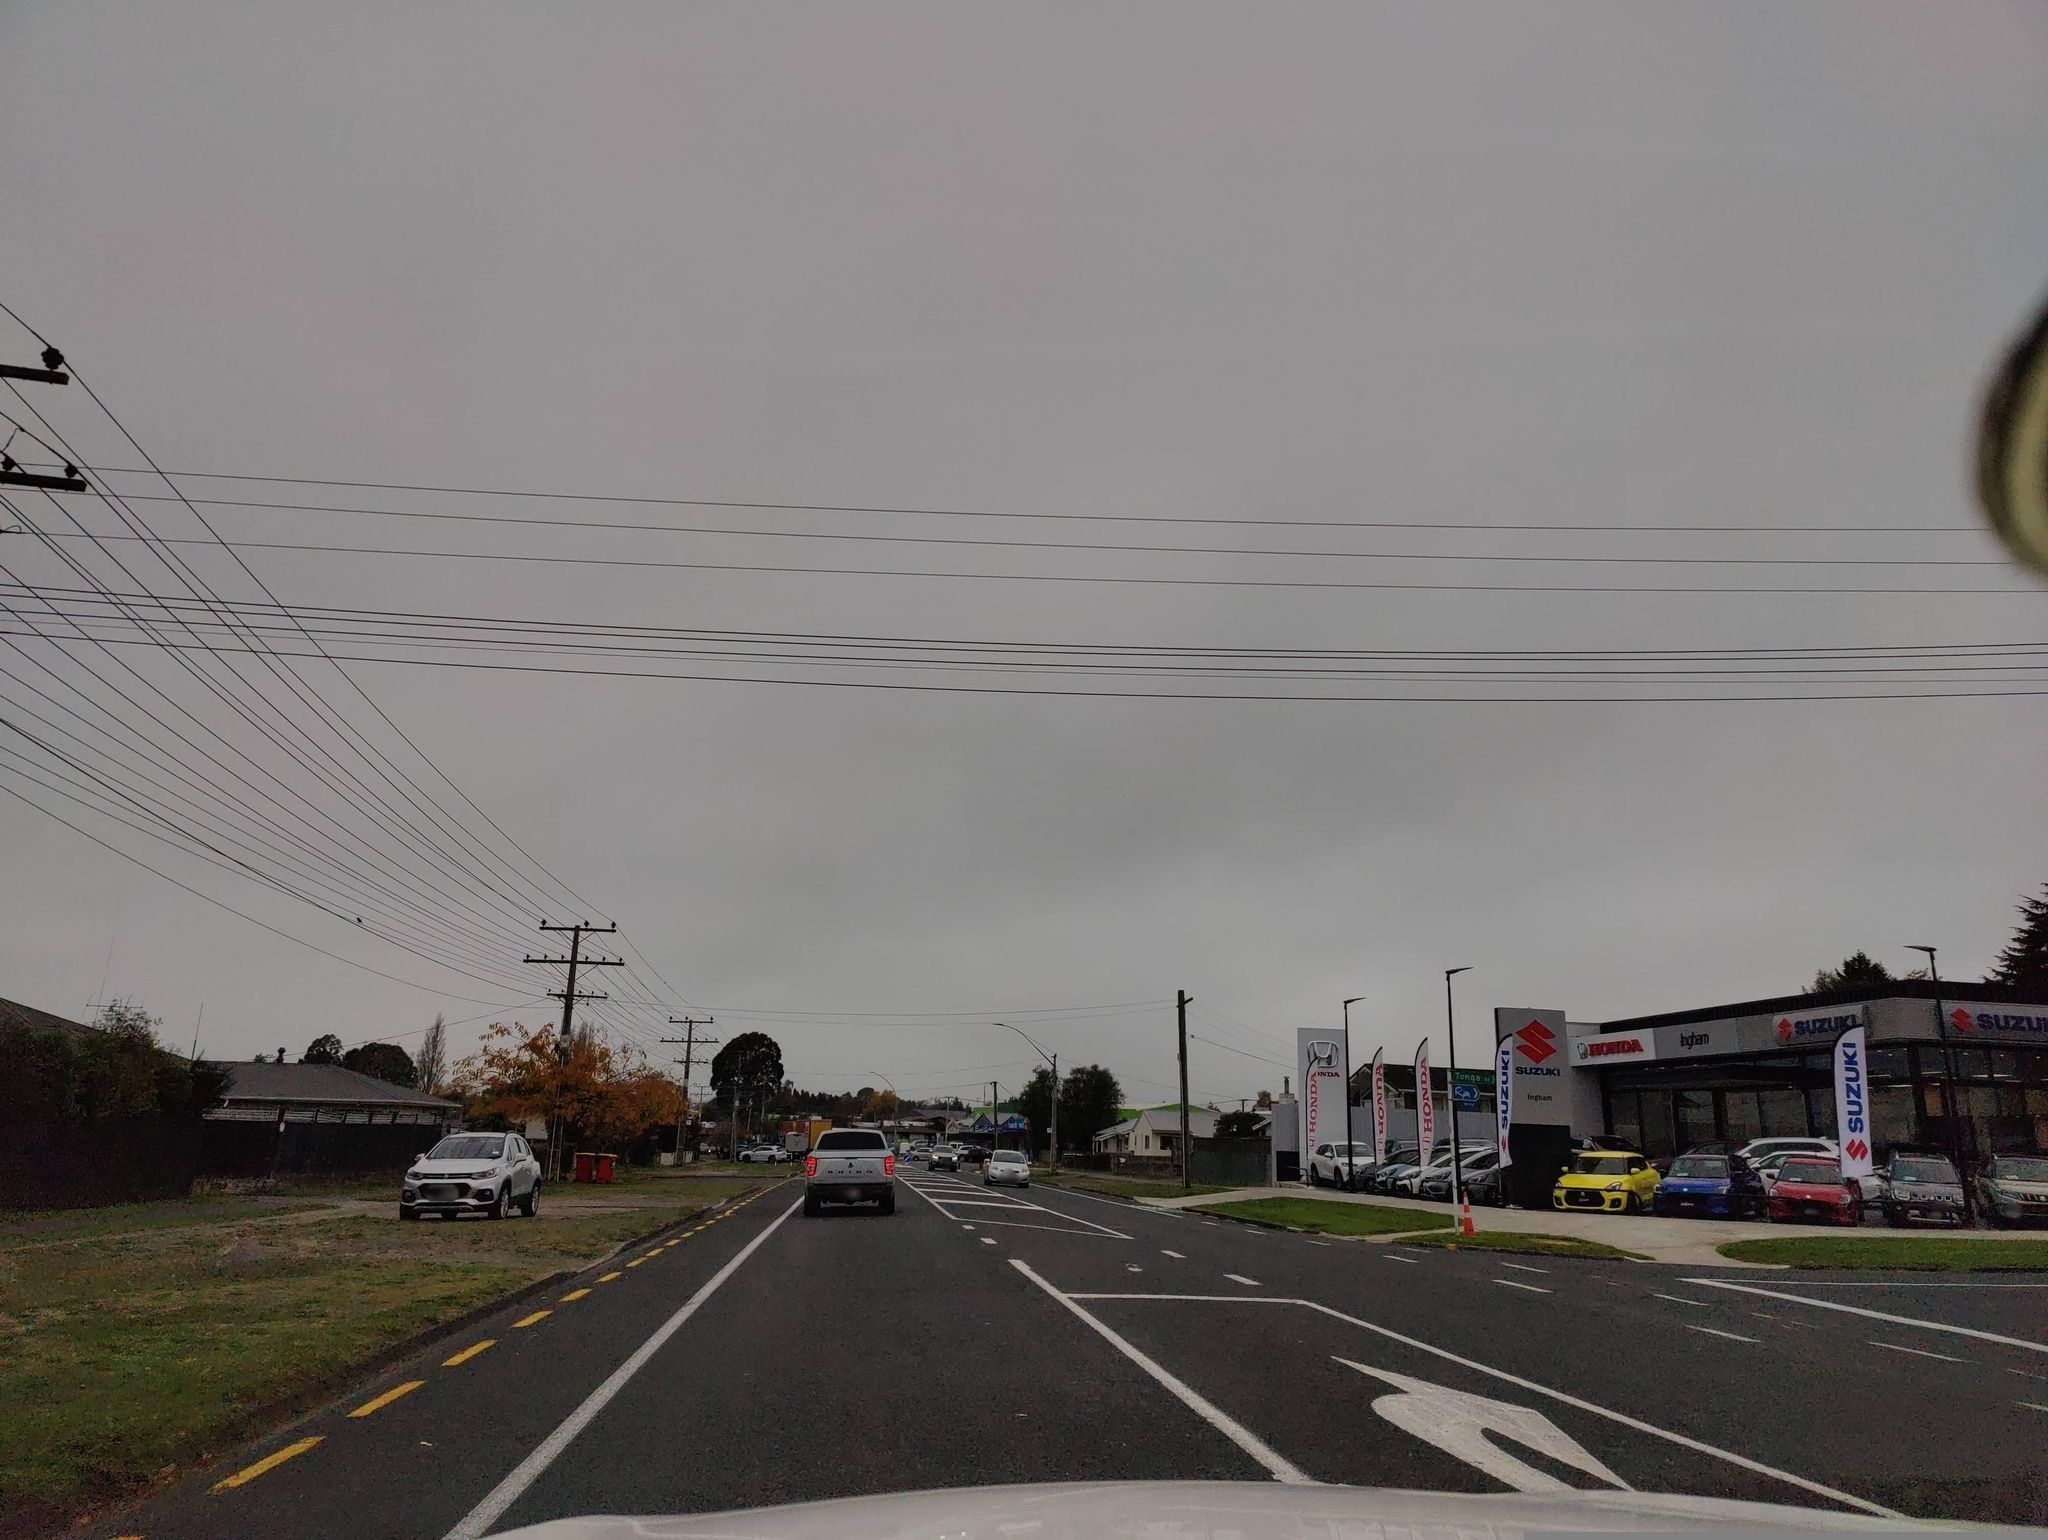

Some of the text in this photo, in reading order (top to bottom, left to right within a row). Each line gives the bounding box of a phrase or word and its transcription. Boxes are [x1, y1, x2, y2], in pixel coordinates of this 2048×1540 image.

[1588, 1039, 1644, 1057] HONDA
[1680, 1031, 1709, 1050] Ingham
[1454, 1072, 1480, 1083] Tonga
[1515, 1066, 1561, 1077] SUZUKI
[1421, 1056, 1433, 1133] HONDA
[1501, 1050, 1511, 1130] SUZUKI
[1527, 1093, 1553, 1102] Ingham
[1842, 1042, 1865, 1134] SUZUKI
[1309, 1072, 1318, 1133] HONDA
